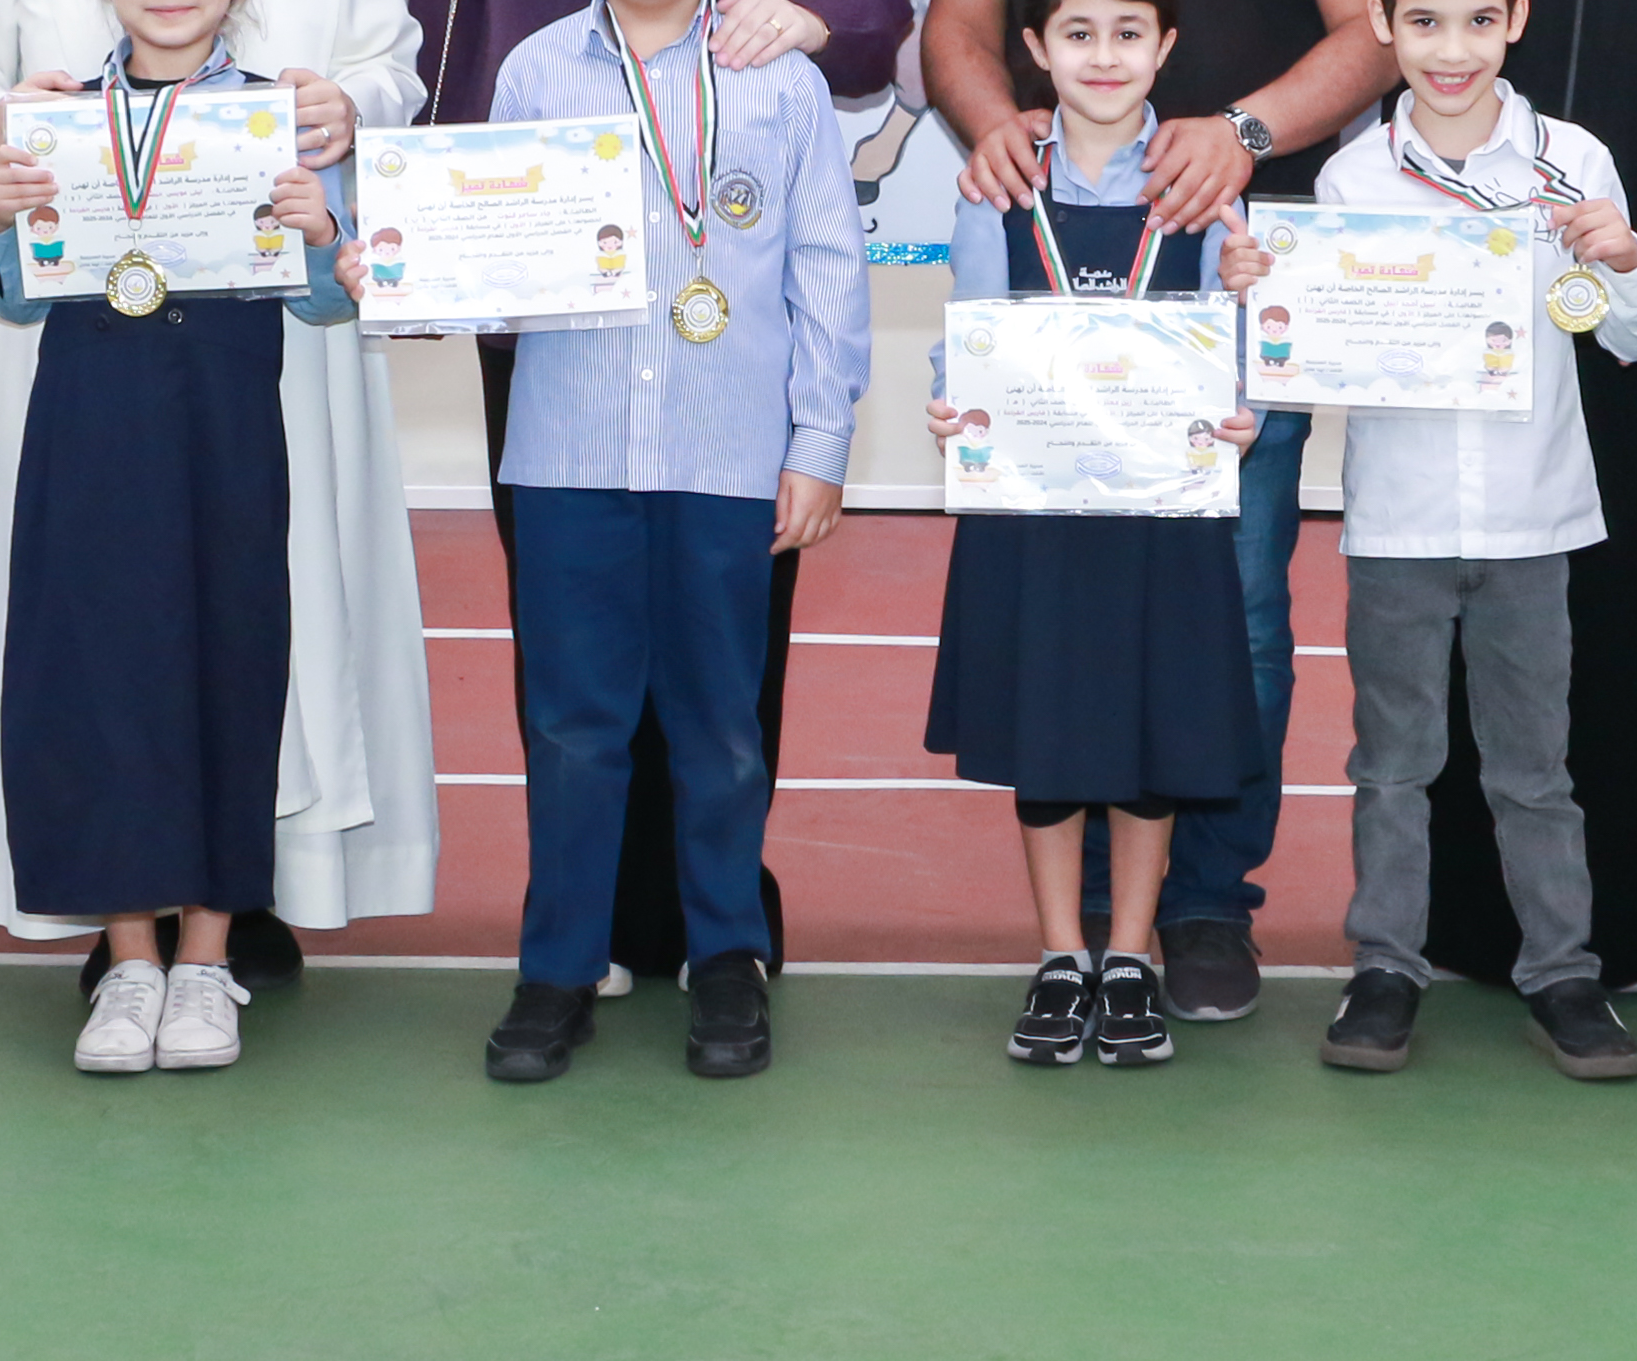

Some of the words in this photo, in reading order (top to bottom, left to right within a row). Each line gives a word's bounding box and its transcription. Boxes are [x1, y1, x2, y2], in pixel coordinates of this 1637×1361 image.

[159, 176, 182, 185] الراشد
[213, 174, 231, 183] إدارة
[487, 177, 528, 190] شهادة
[91, 180, 100, 190] أن
[460, 180, 485, 194] تميز
[505, 198, 529, 207] الراشد
[559, 195, 577, 204] إدارة
[477, 200, 502, 211] الصالح
[1379, 265, 1419, 276] شهادة
[1326, 282, 1336, 294] أن
[1366, 286, 1392, 296] الصالح
[1394, 287, 1419, 295] الراشد
[1420, 287, 1447, 296] مدرسة
[1449, 288, 1467, 297] إدارة
[1085, 361, 1123, 374] شهادة
[1026, 383, 1036, 395] أن
[1121, 387, 1149, 395] مدرسة
